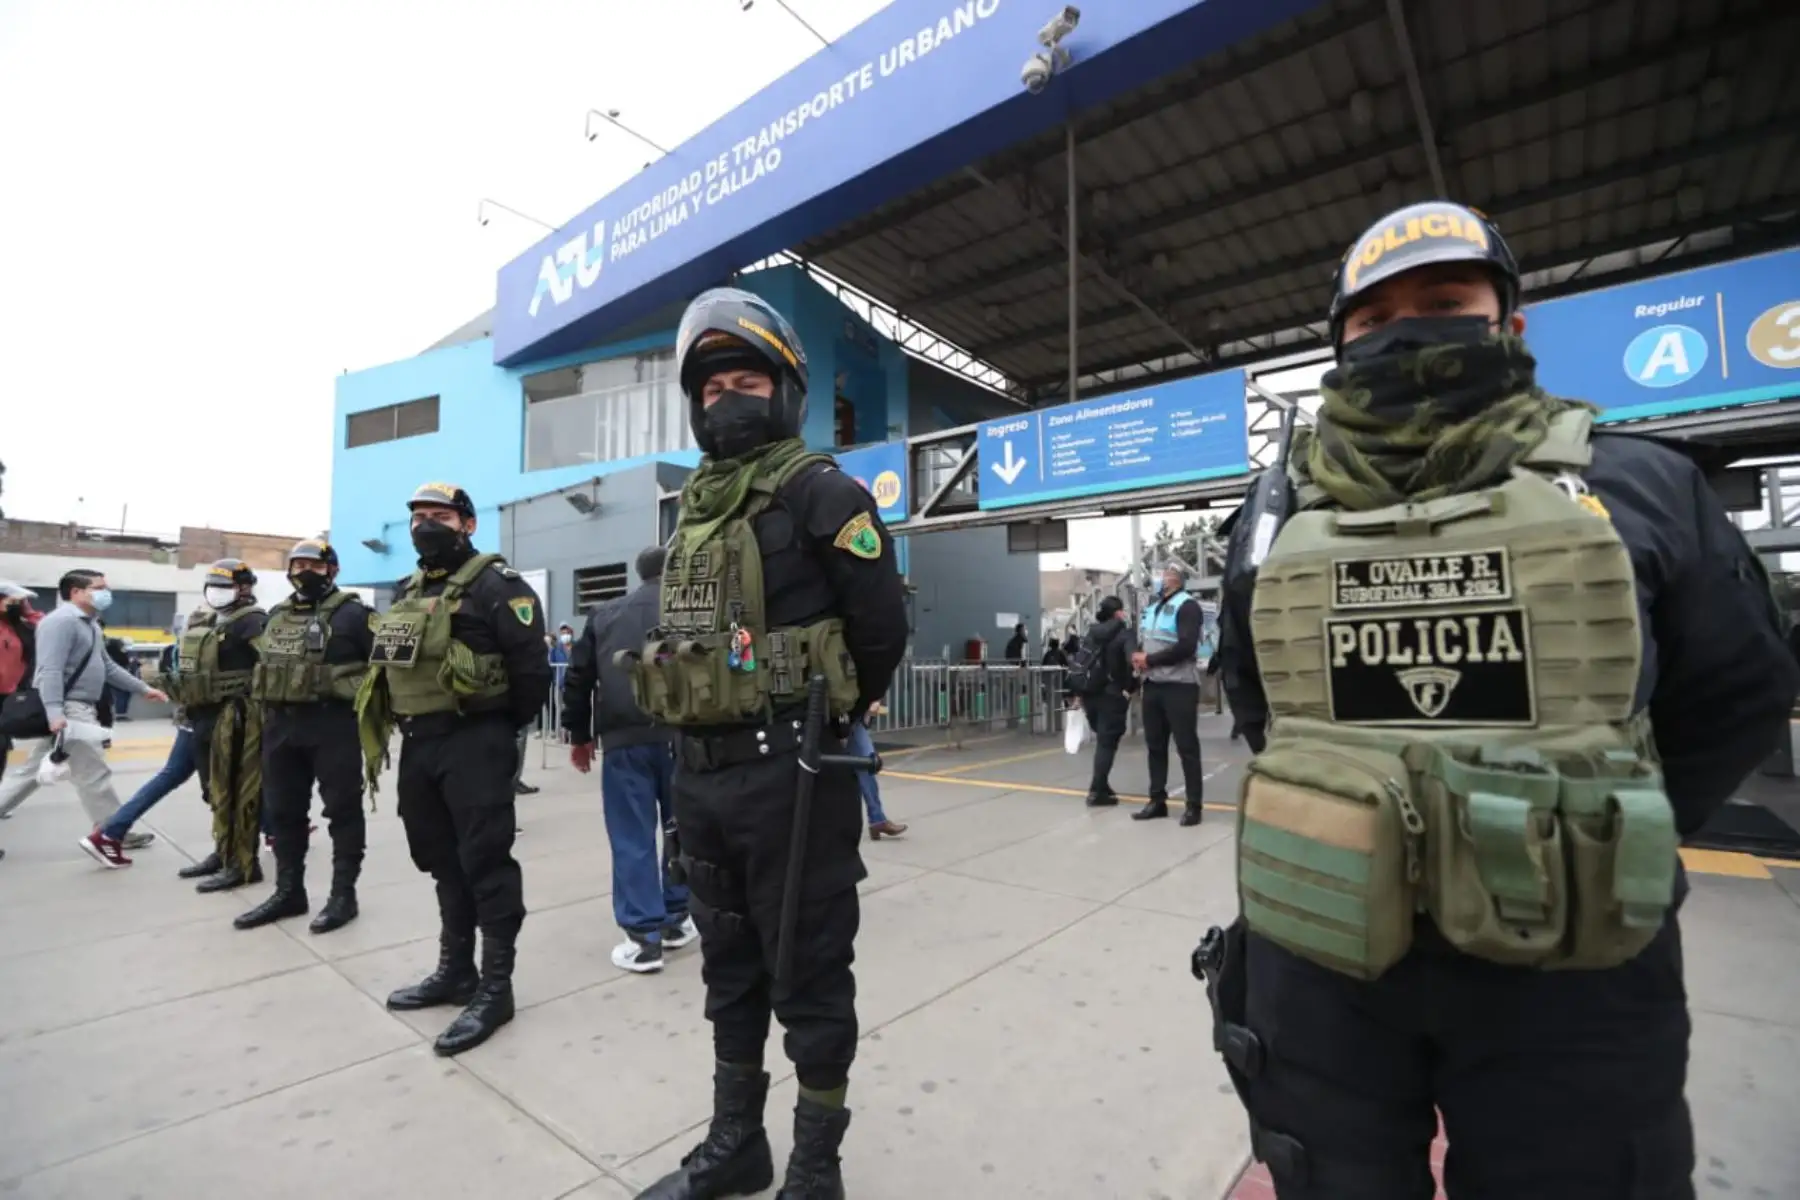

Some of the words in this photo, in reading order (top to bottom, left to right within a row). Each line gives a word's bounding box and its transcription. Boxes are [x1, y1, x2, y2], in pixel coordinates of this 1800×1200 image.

[611, 171, 703, 241] AUTORIDAD
[705, 152, 728, 182] DE
[731, 62, 874, 165] TRANSPORTE
[879, 0, 999, 77] URBANO
[611, 234, 647, 262] PARA
[650, 211, 689, 241] LIMA
[691, 193, 703, 214] Y
[706, 148, 782, 206] CALLAO
[528, 220, 605, 317] ATU
[1345, 213, 1489, 290] POLICIA
[1634, 295, 1705, 319] Regular
[1639, 331, 1690, 381] A
[986, 419, 1029, 438] Ingreso
[1048, 414, 1074, 427] Zona
[1076, 396, 1155, 421] Alimentadoras
[1338, 564, 1360, 586] L.
[1368, 557, 1465, 585] OVALLE
[1471, 555, 1498, 579] R.
[663, 583, 715, 611] POLICIA
[1340, 584, 1425, 603] SUBOFICIAL
[1330, 613, 1523, 668] POLICIA
